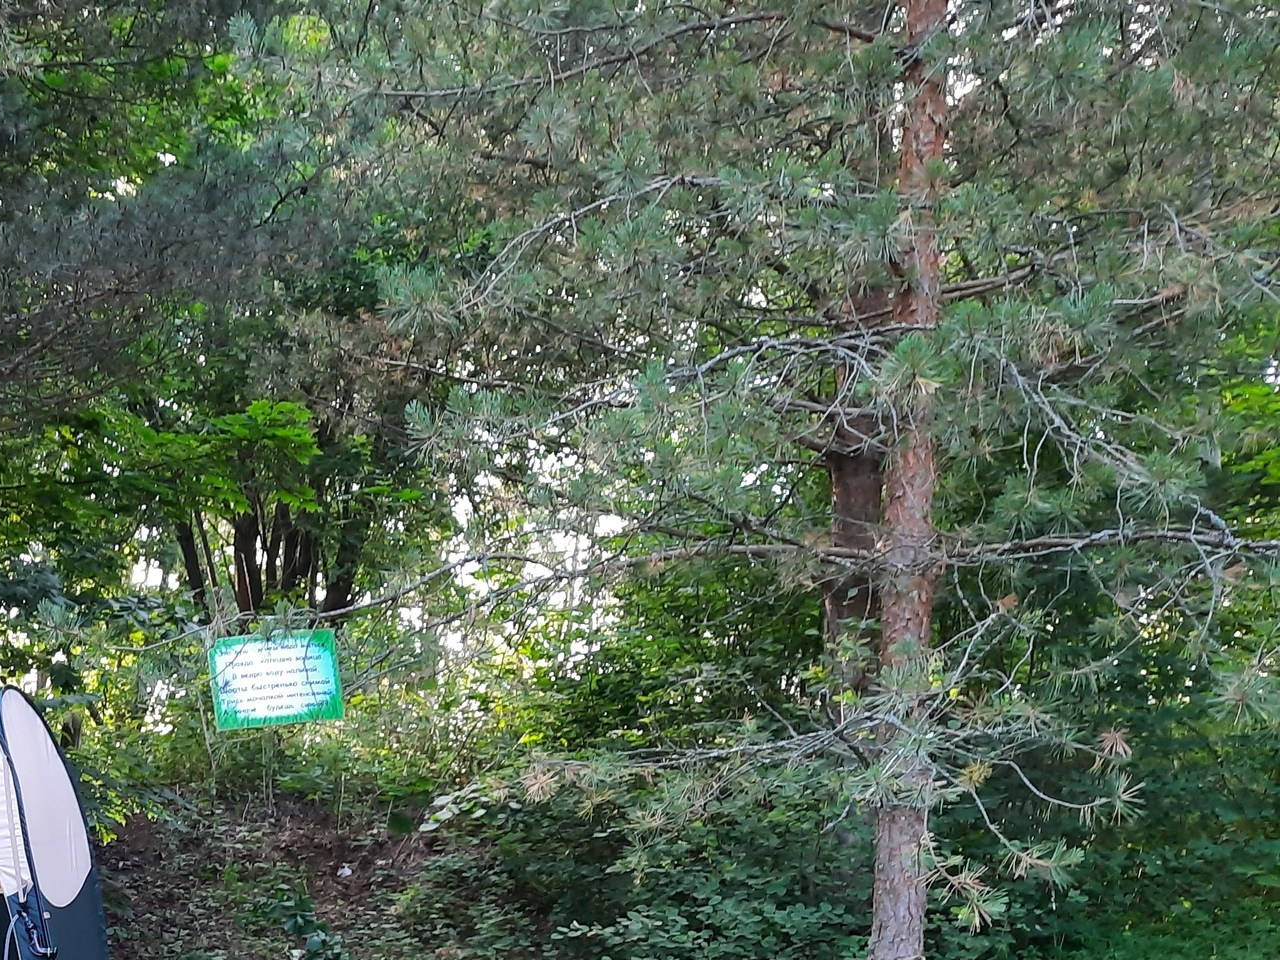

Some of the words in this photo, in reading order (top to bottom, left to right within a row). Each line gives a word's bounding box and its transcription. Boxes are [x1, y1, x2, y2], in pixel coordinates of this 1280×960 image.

[240, 671, 263, 679] ведро
[251, 681, 298, 691] быстренько
[221, 698, 244, 707] Трись
[246, 693, 284, 702] мочалкой
[266, 704, 295, 712] будешь
